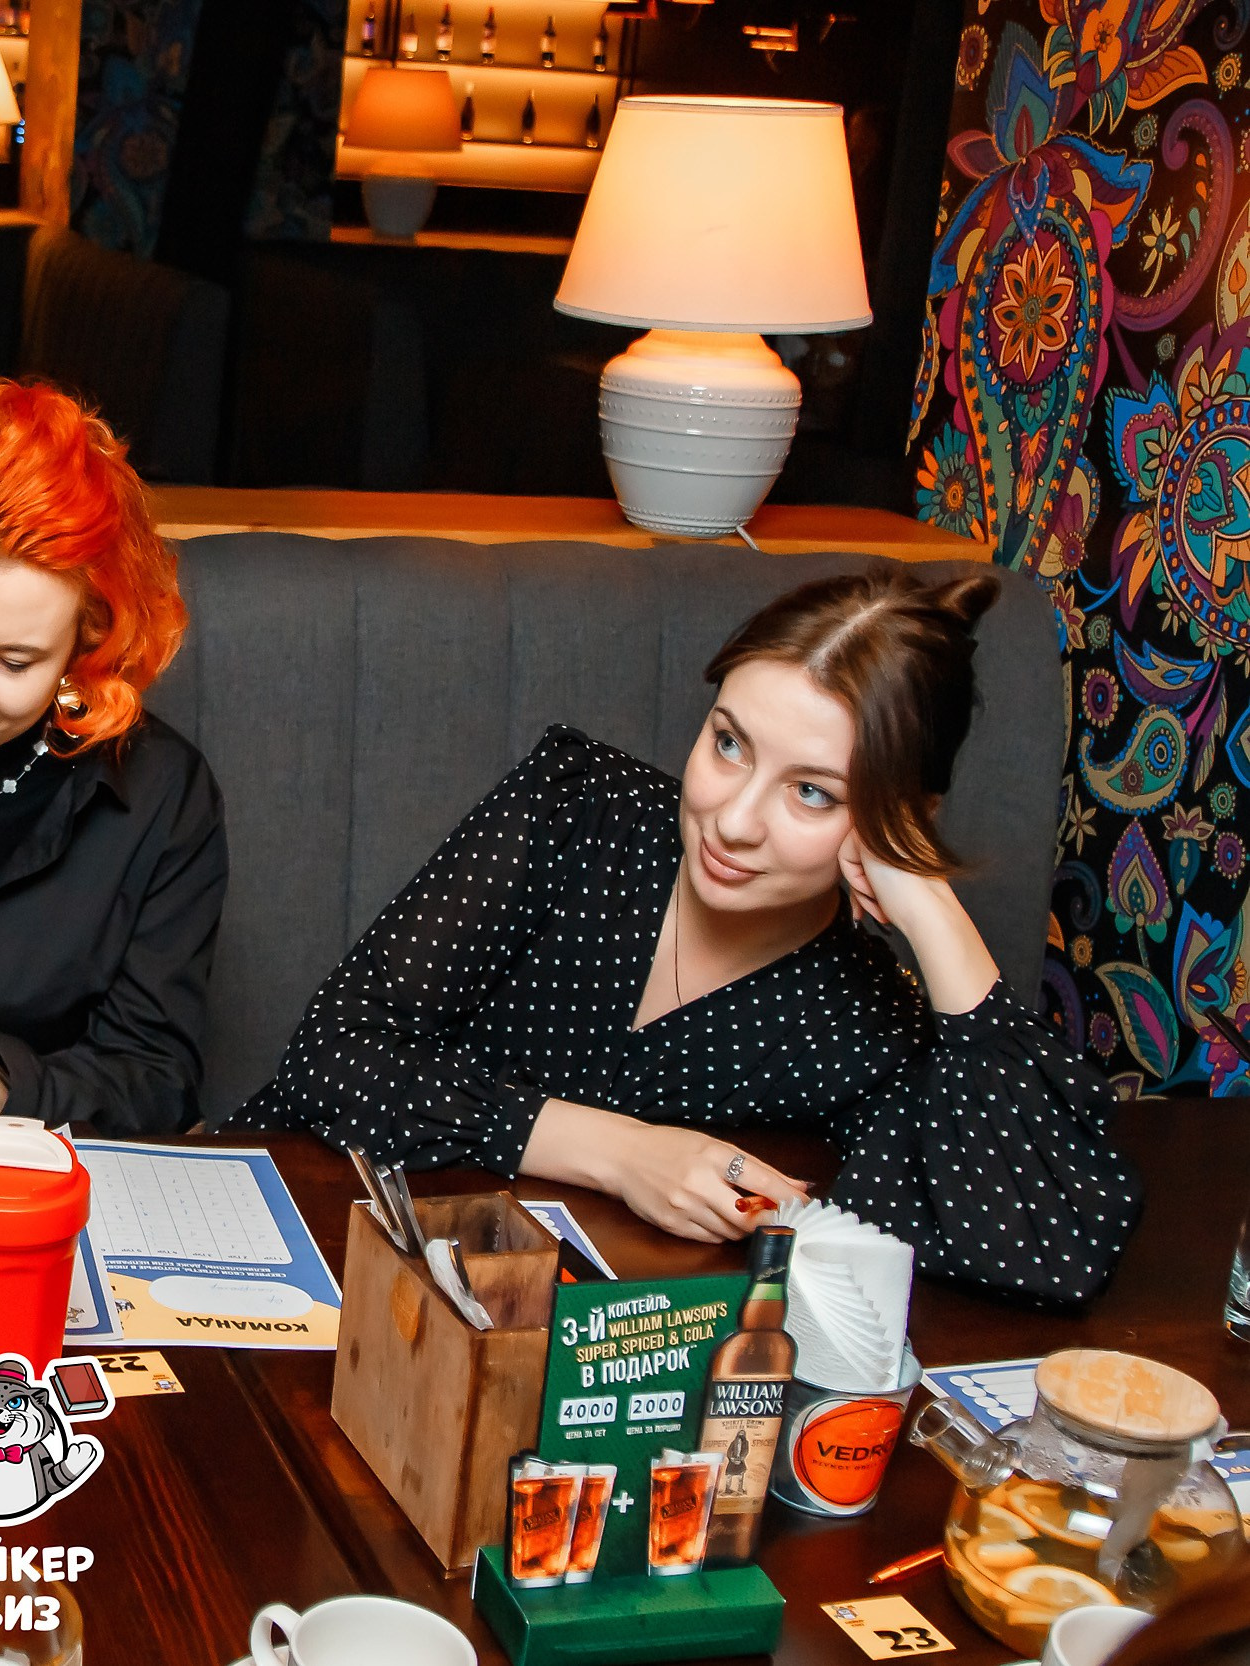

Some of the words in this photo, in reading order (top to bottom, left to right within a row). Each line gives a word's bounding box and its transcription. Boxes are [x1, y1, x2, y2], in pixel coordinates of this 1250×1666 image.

[175, 1316, 310, 1333] КОМАНДА
[561, 1307, 606, 1346] 3-Й
[608, 1293, 671, 1319] КОКТЕЙЛЬ
[608, 1313, 663, 1338] WILLIAM
[667, 1302, 728, 1327] LAWSON'S
[576, 1343, 617, 1363] SUPER
[622, 1334, 665, 1355] SPICED
[669, 1331, 679, 1346] &
[97, 1356, 149, 1374] 22
[582, 1365, 595, 1388] В
[717, 1384, 784, 1400] WILLIAM
[563, 1401, 614, 1419] 4000
[632, 1397, 682, 1415] 2000
[565, 1430, 583, 1440] ЦЕНА
[584, 1429, 593, 1439] ЗА
[594, 1428, 607, 1438] СЕТ
[626, 1426, 644, 1436] ЦЕНА
[645, 1425, 654, 1434] ЗА
[655, 1424, 682, 1433] ПОРЦИЮ
[873, 1627, 940, 1653] 23
